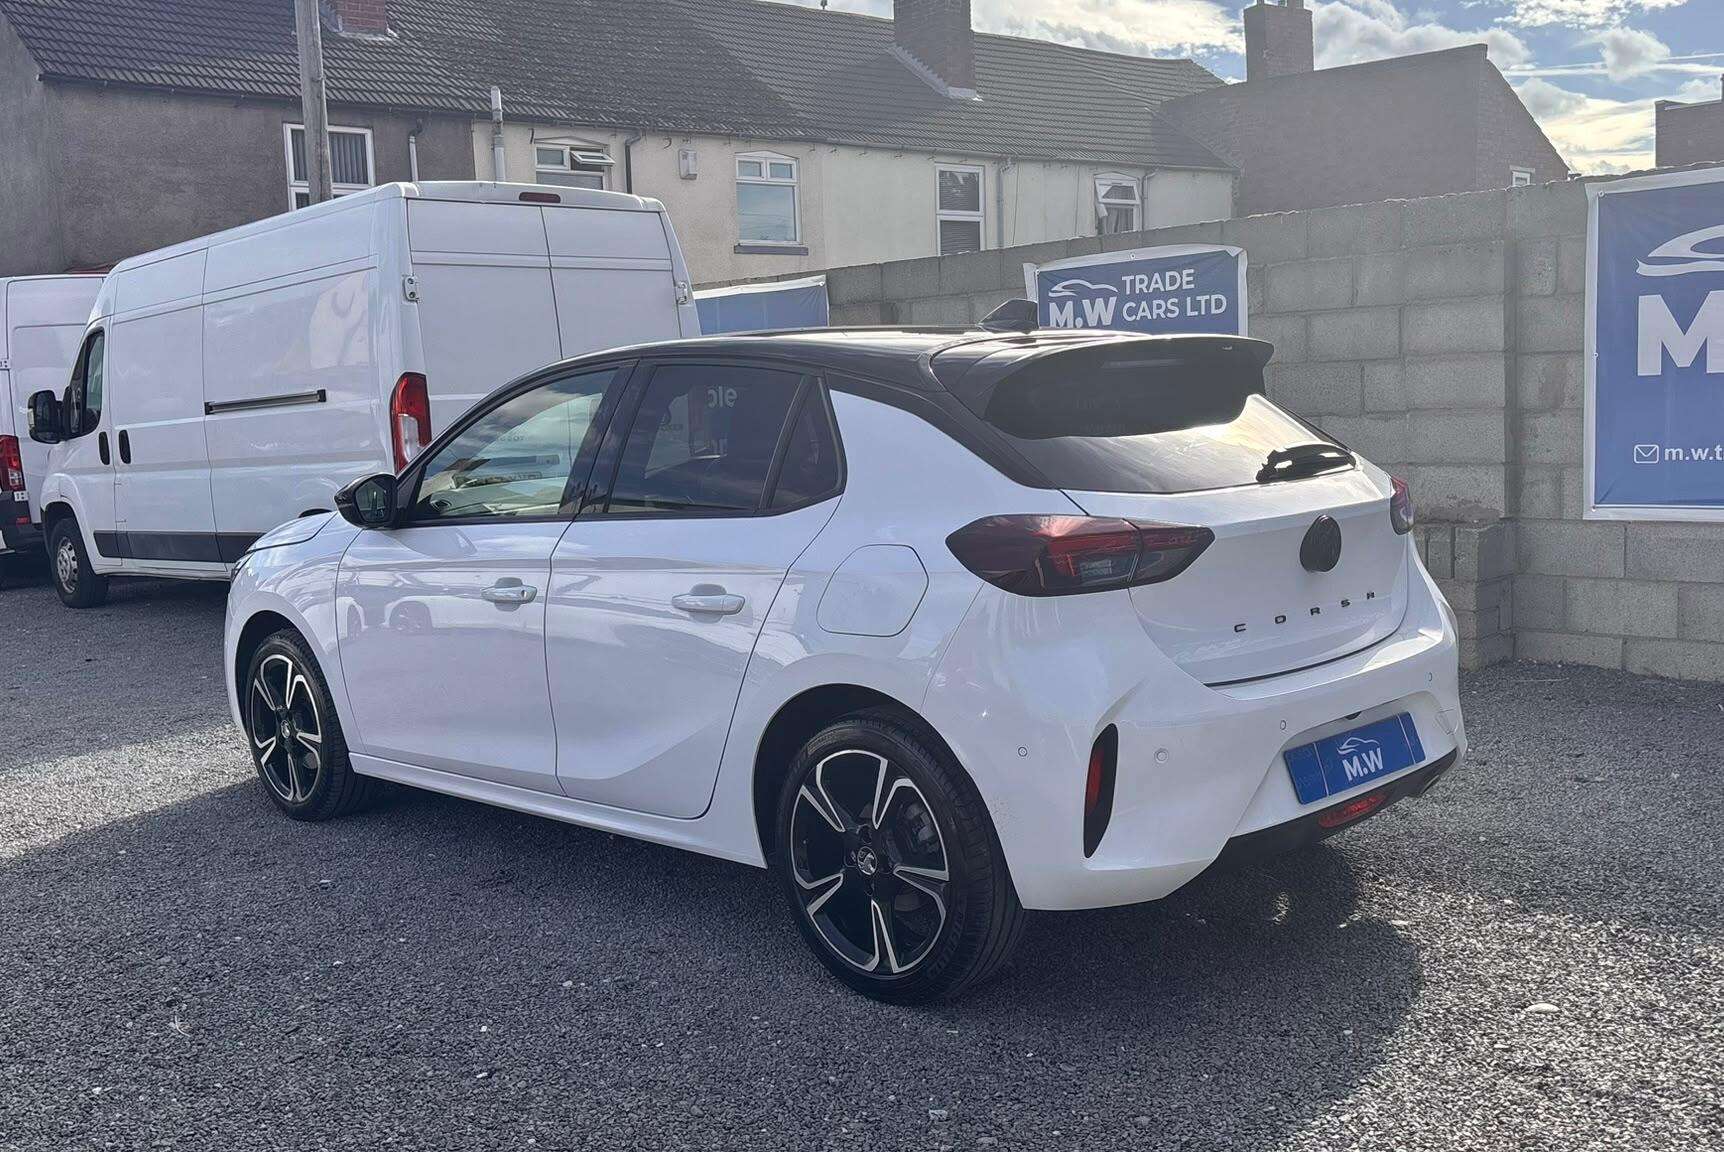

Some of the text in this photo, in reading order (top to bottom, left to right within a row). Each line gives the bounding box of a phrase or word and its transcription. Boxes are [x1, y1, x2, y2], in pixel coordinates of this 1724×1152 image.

[1121, 268, 1195, 295] TRADE
[1049, 296, 1117, 329] M.W
[1122, 294, 1227, 322] CARS LTD
[1664, 444, 1724, 461] m.w.t
[1233, 591, 1375, 633] CORSA
[1342, 747, 1384, 781] M.W
